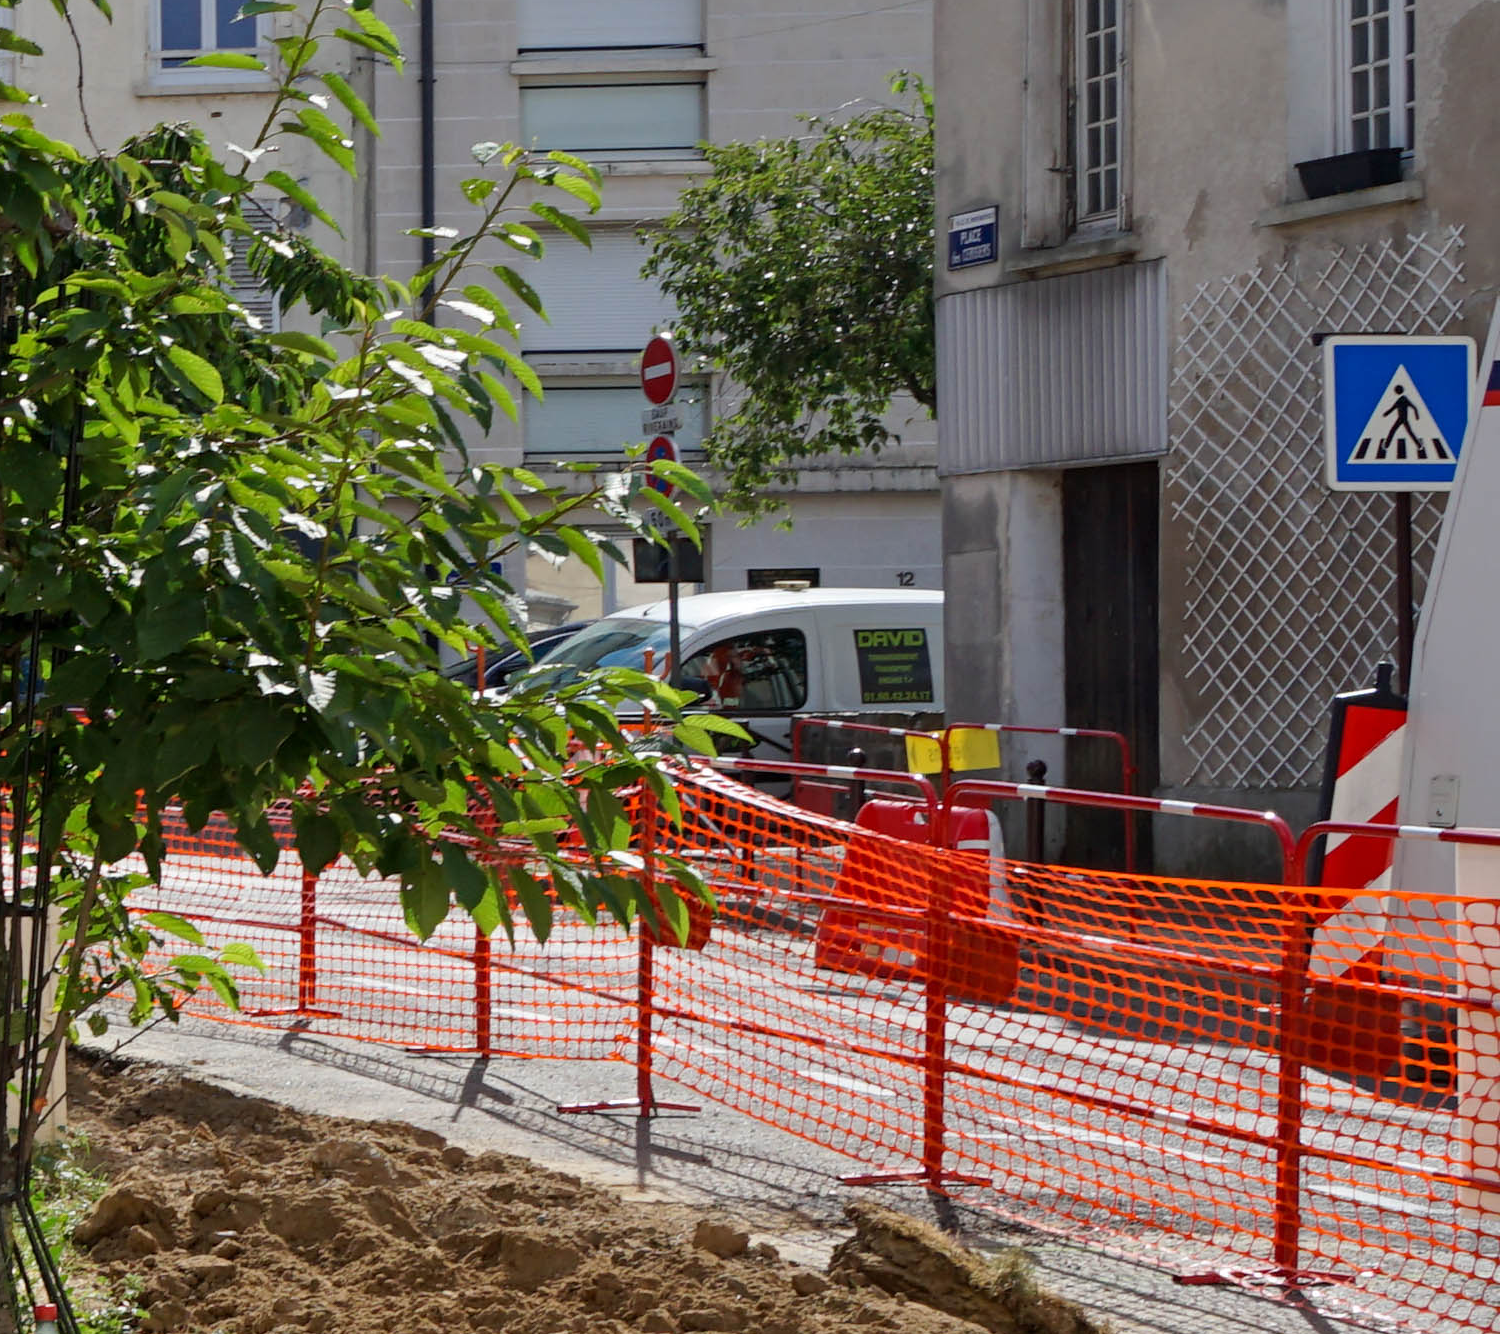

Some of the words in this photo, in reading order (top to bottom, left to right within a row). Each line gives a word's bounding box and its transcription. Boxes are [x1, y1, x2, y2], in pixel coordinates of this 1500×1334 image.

[960, 228, 982, 245] PLACE
[896, 572, 915, 586] 12
[858, 631, 924, 647] DAVID
